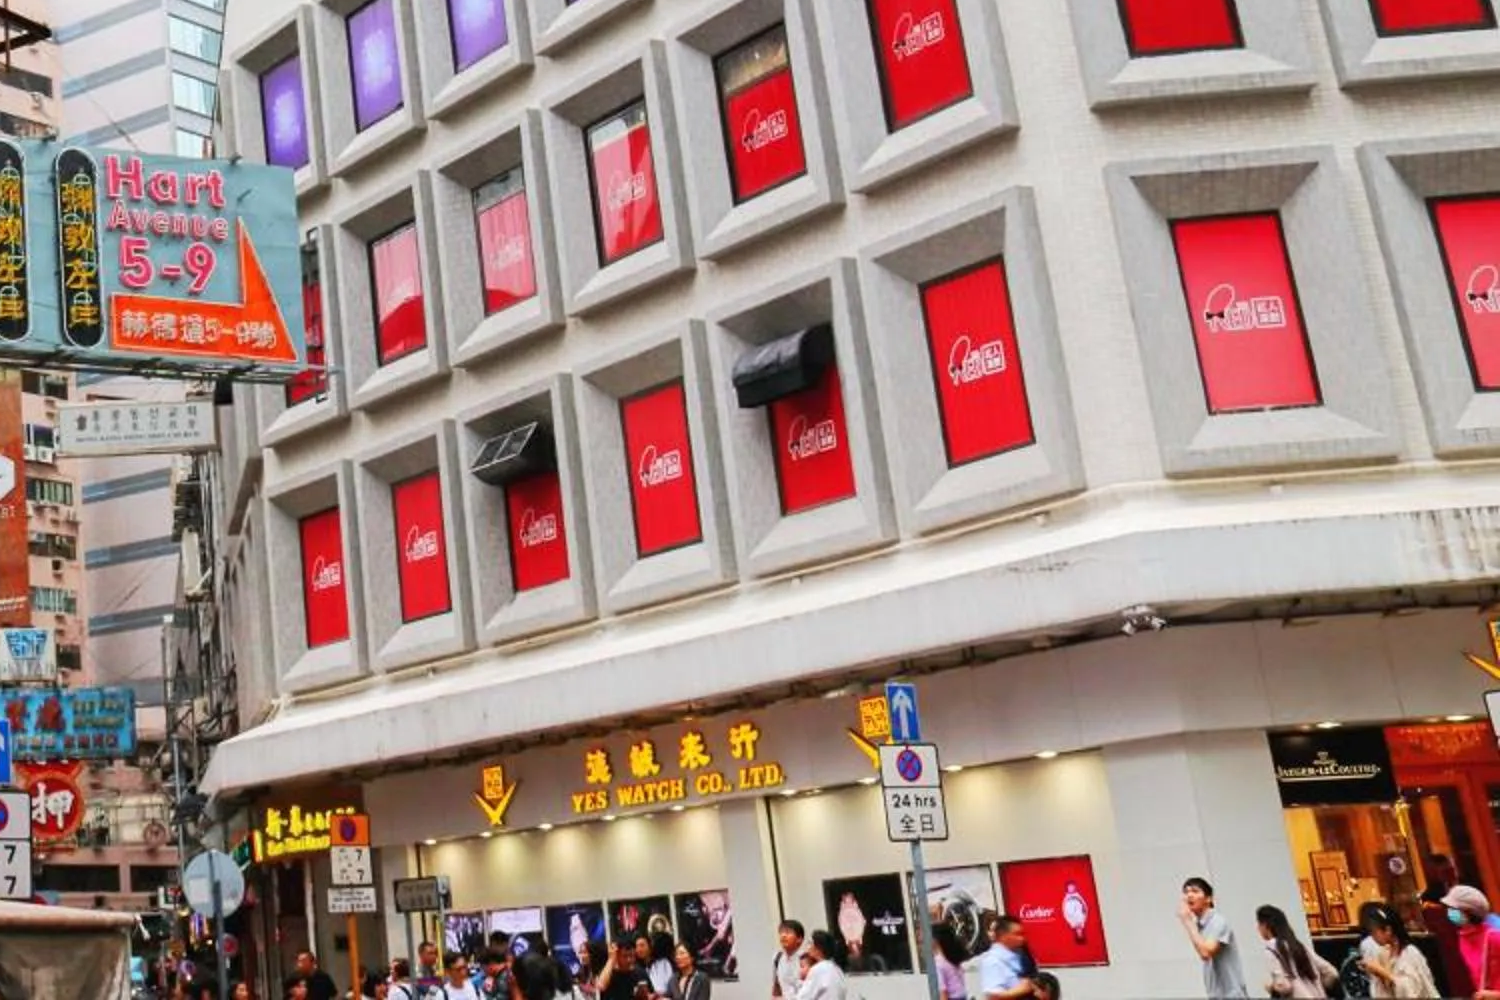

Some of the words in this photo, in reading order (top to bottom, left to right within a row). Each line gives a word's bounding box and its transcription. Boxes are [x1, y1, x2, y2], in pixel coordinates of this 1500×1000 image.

[105, 154, 227, 209] Hart
[107, 200, 229, 240] Avenue
[119, 236, 218, 293] 5-9
[32, 781, 75, 829] 押
[572, 791, 609, 814] YES
[616, 779, 686, 807] WATCH
[739, 762, 786, 789] LTD.
[891, 793, 911, 809] 24
[914, 793, 937, 809] hrs
[900, 813, 935, 834] 全日
[4, 845, 17, 864] 7
[4, 875, 17, 895] 7
